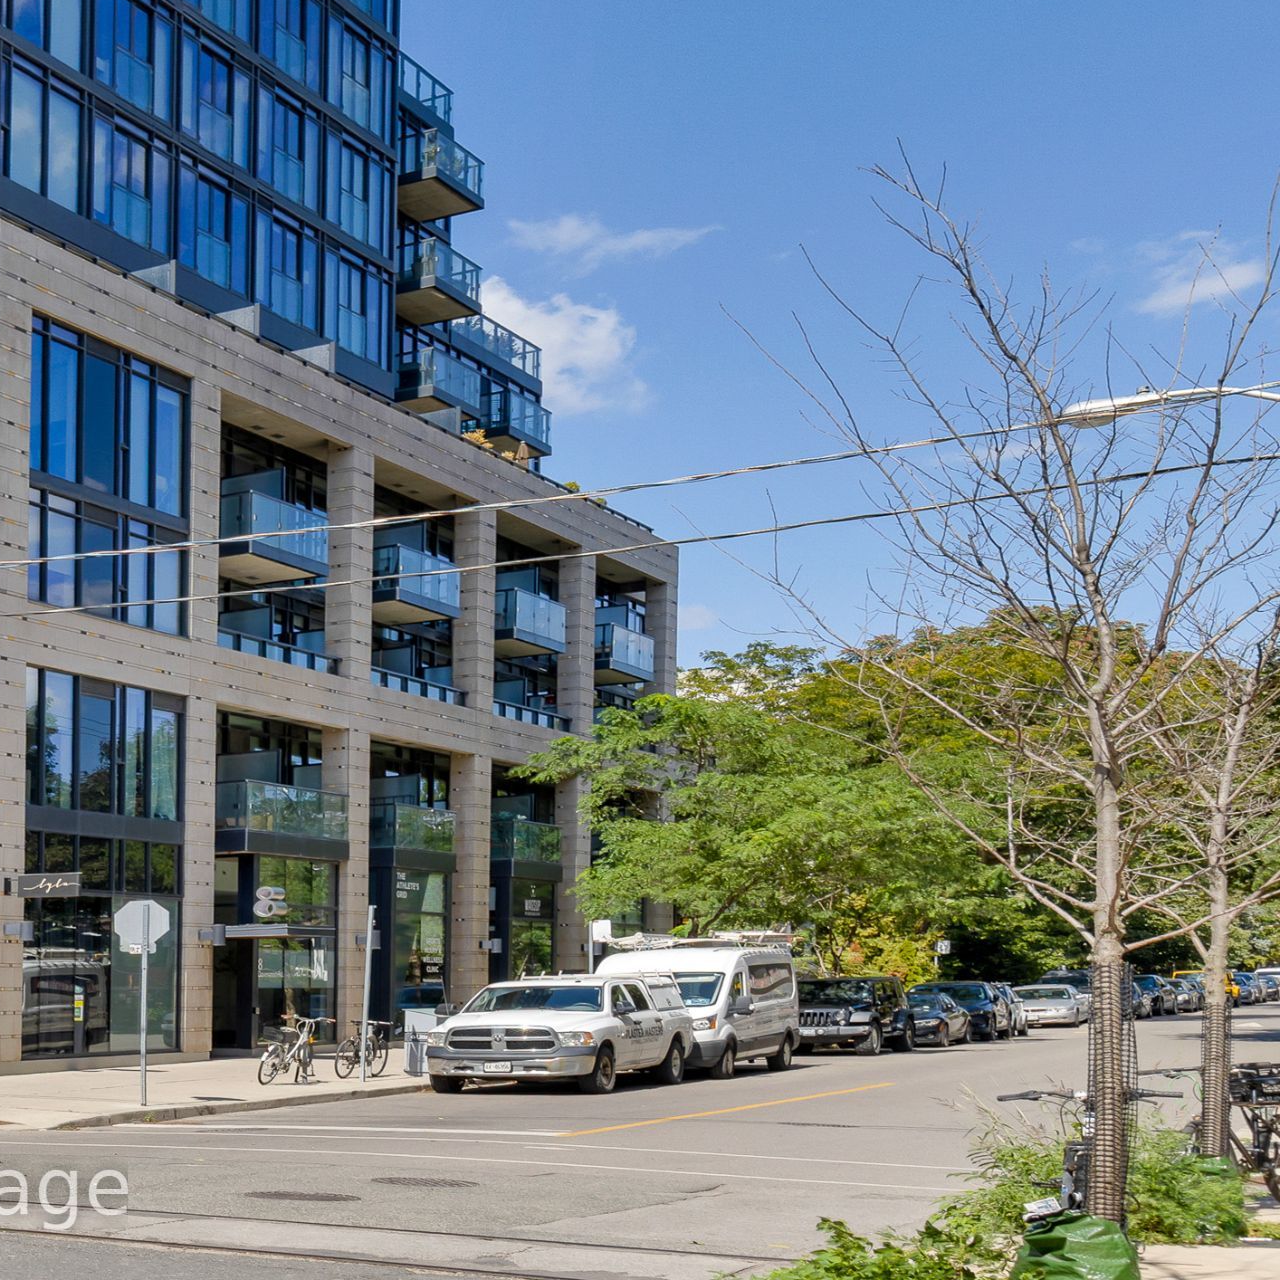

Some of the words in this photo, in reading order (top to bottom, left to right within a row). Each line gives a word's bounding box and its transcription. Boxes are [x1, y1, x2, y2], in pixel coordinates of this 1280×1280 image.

[396, 872, 406, 880] THE
[396, 882, 420, 891] ATHLETE'S
[258, 958, 263, 970] 8
